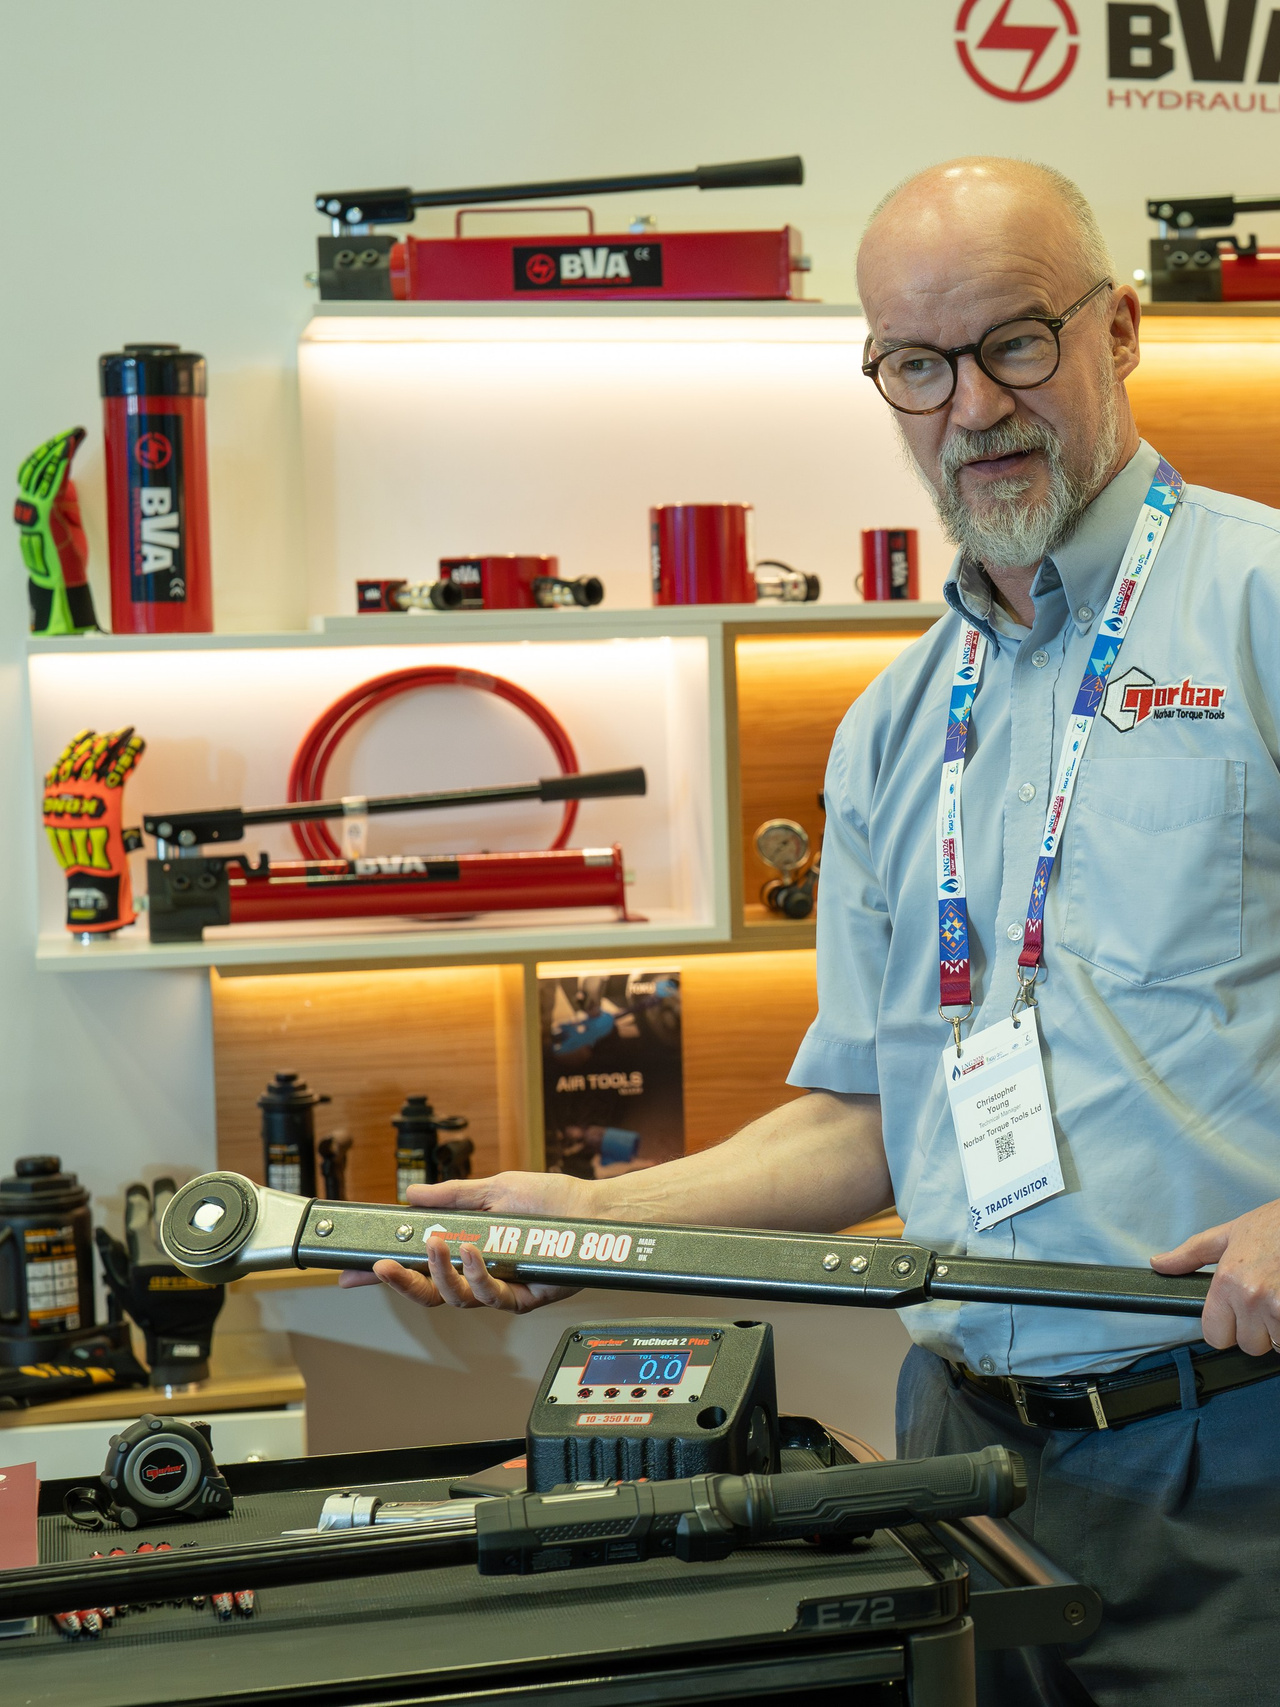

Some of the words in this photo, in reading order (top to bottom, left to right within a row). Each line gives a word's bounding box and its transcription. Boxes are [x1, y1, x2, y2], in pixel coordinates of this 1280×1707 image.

[560, 247, 631, 279] BVA
[141, 487, 180, 574] BVA
[1153, 709, 1175, 719] Norbar
[1176, 708, 1203, 720] Torque
[1204, 709, 1225, 719] Tools
[355, 856, 427, 875] BVA
[942, 838, 950, 877] LNG2026
[556, 1075, 586, 1092] AIR
[587, 1071, 643, 1090] TOOLS
[976, 1084, 1017, 1109] Christopher
[987, 1099, 1010, 1115] Young
[963, 1134, 986, 1150] Norbar
[986, 1121, 1010, 1138] Torque
[1010, 1111, 1029, 1125] Tools
[1030, 1104, 1042, 1116] Ltd
[979, 1113, 1001, 1129] Technical
[1000, 1104, 1022, 1119] Manager
[985, 1195, 1013, 1216] TRADE
[1013, 1176, 1048, 1201] VISITOR
[483, 1225, 522, 1254] XR
[523, 1228, 576, 1259] PRO
[579, 1232, 632, 1263] 800
[638, 1238, 656, 1246] MADE
[638, 1254, 648, 1262] UK
[633, 1338, 679, 1346] TruCheck
[680, 1338, 688, 1346] 2
[688, 1338, 710, 1346] Plus
[639, 1359, 682, 1380] 0.0
[586, 1415, 596, 1423] 10
[603, 1415, 622, 1423] 350
[817, 1597, 896, 1630] E72
